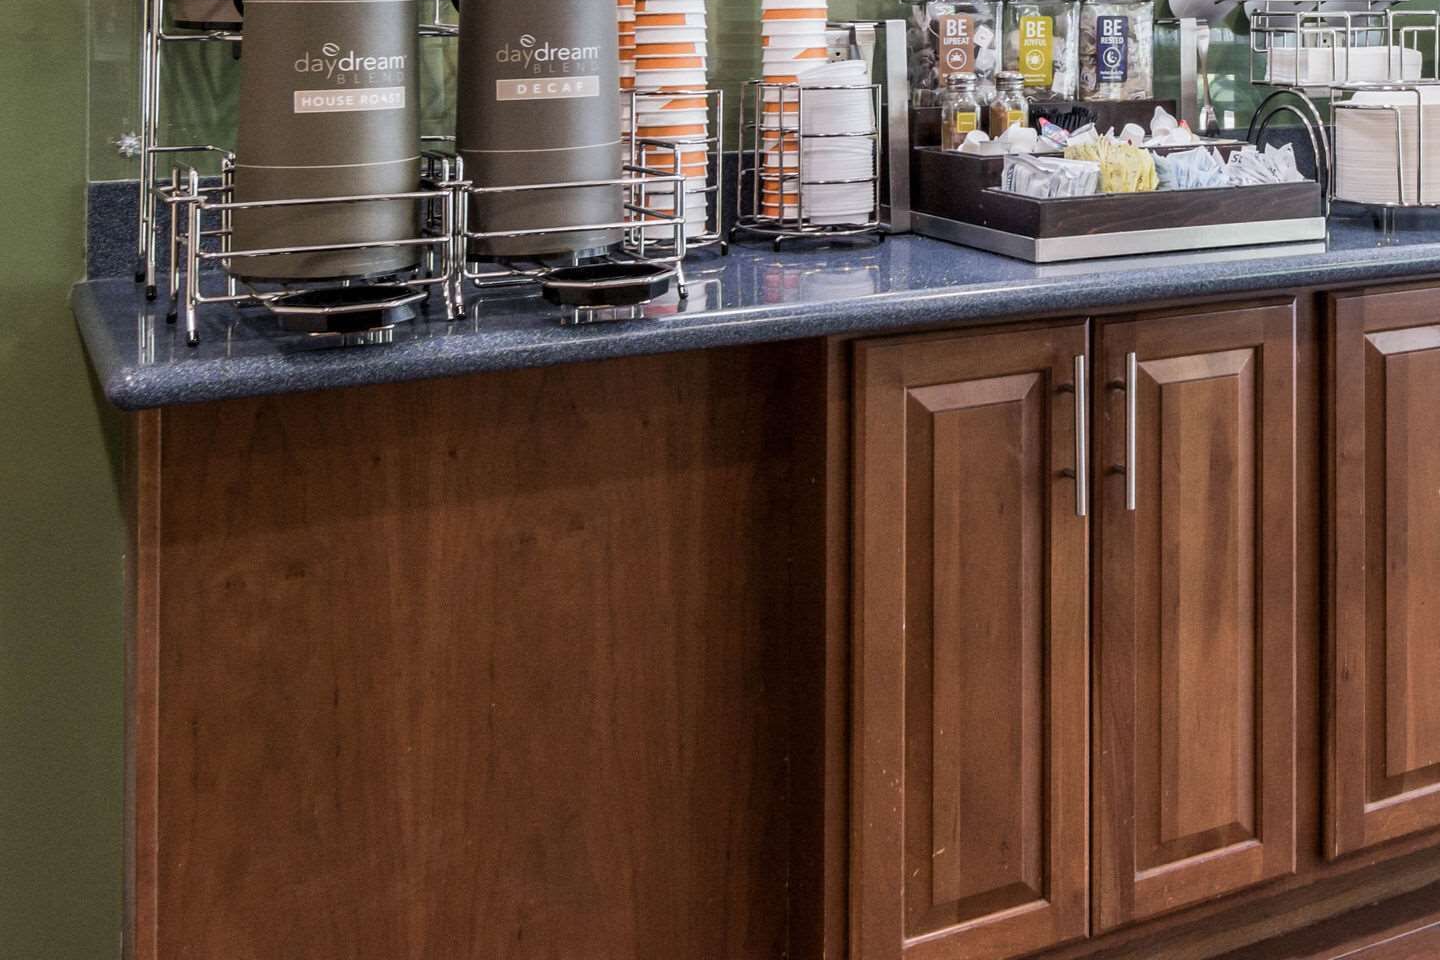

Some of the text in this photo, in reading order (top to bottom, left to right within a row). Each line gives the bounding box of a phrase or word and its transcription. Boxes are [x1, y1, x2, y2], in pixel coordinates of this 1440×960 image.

[946, 19, 968, 36] BE
[1026, 21, 1046, 38] BE
[1103, 19, 1123, 36] BE
[495, 41, 599, 70] daydream
[294, 50, 406, 80] daydream
[517, 81, 585, 95] DECAF
[302, 92, 402, 107] HOUSE ROAST
